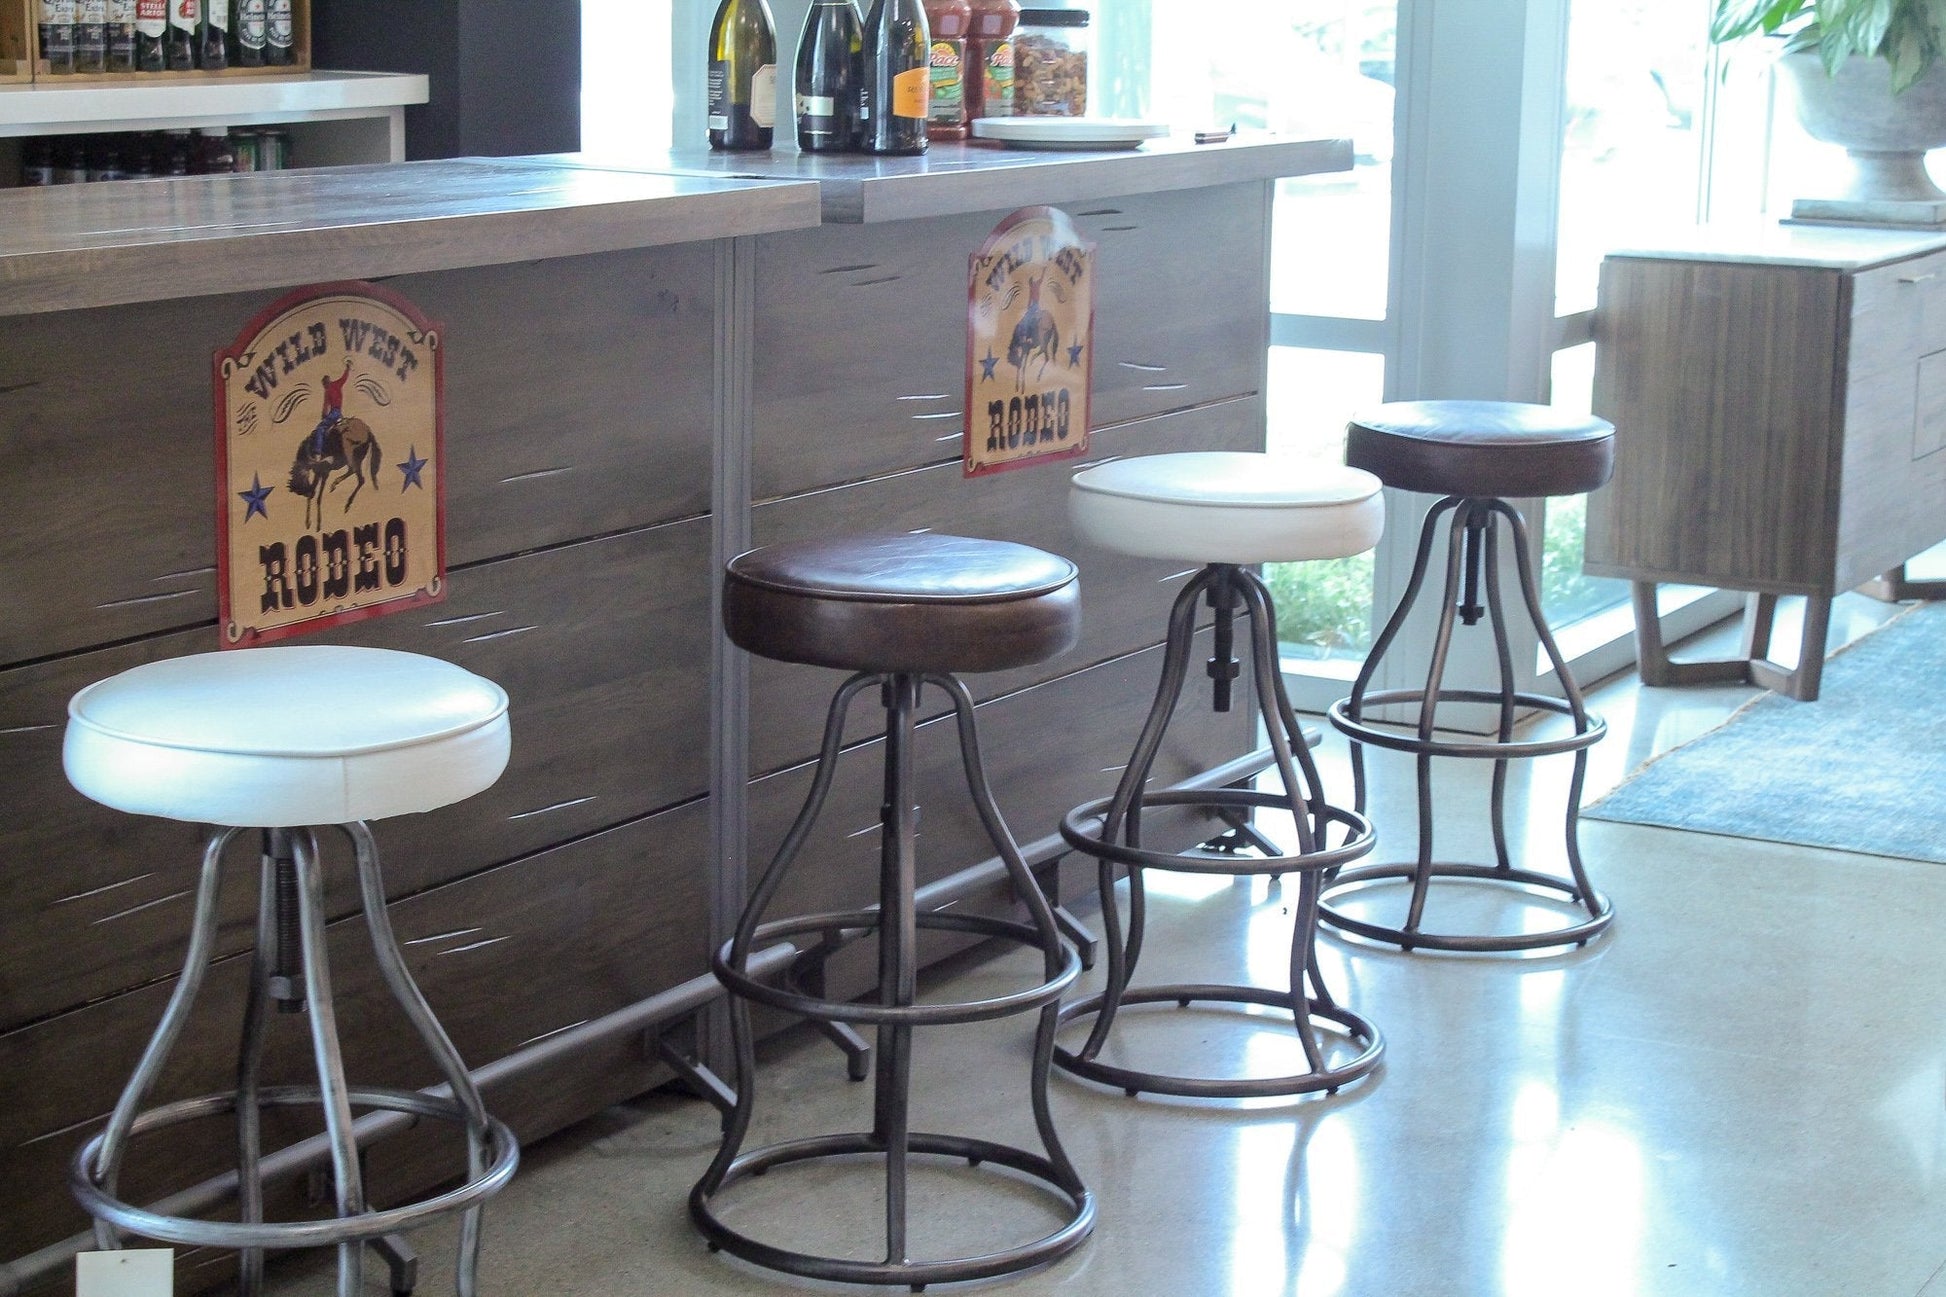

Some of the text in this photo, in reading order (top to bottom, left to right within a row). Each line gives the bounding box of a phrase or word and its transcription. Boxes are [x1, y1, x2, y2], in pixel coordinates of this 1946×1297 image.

[986, 237, 1033, 291] WILD
[245, 318, 419, 400] WILD WEST
[986, 387, 1071, 453] RODEO
[259, 517, 409, 616] RODEO
